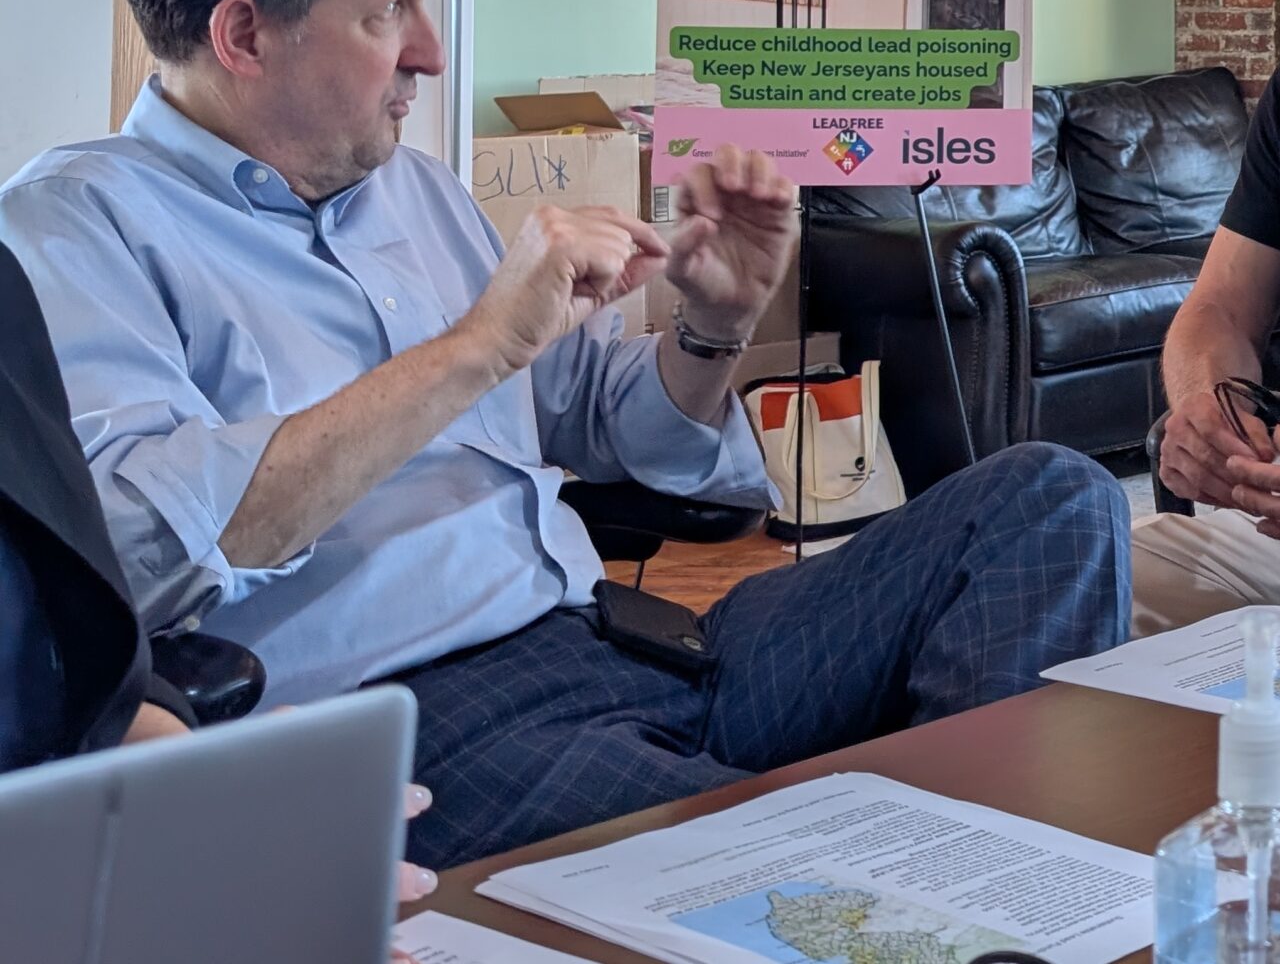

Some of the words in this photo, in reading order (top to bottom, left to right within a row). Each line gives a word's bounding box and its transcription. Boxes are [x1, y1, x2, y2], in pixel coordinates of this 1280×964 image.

[679, 34, 756, 52] Reduce
[761, 35, 862, 53] childhood
[868, 37, 911, 53] lead
[916, 38, 1012, 58] poisoning
[702, 59, 755, 80] Keep
[761, 60, 806, 77] New
[811, 61, 910, 81] Jerseyans
[916, 61, 988, 78] housed
[729, 84, 803, 101] Sustain
[808, 85, 846, 101] and
[851, 87, 916, 102] create
[918, 85, 962, 105] jobs
[839, 132, 858, 143] NJ
[902, 126, 996, 164] isles
[692, 148, 713, 158] Green
